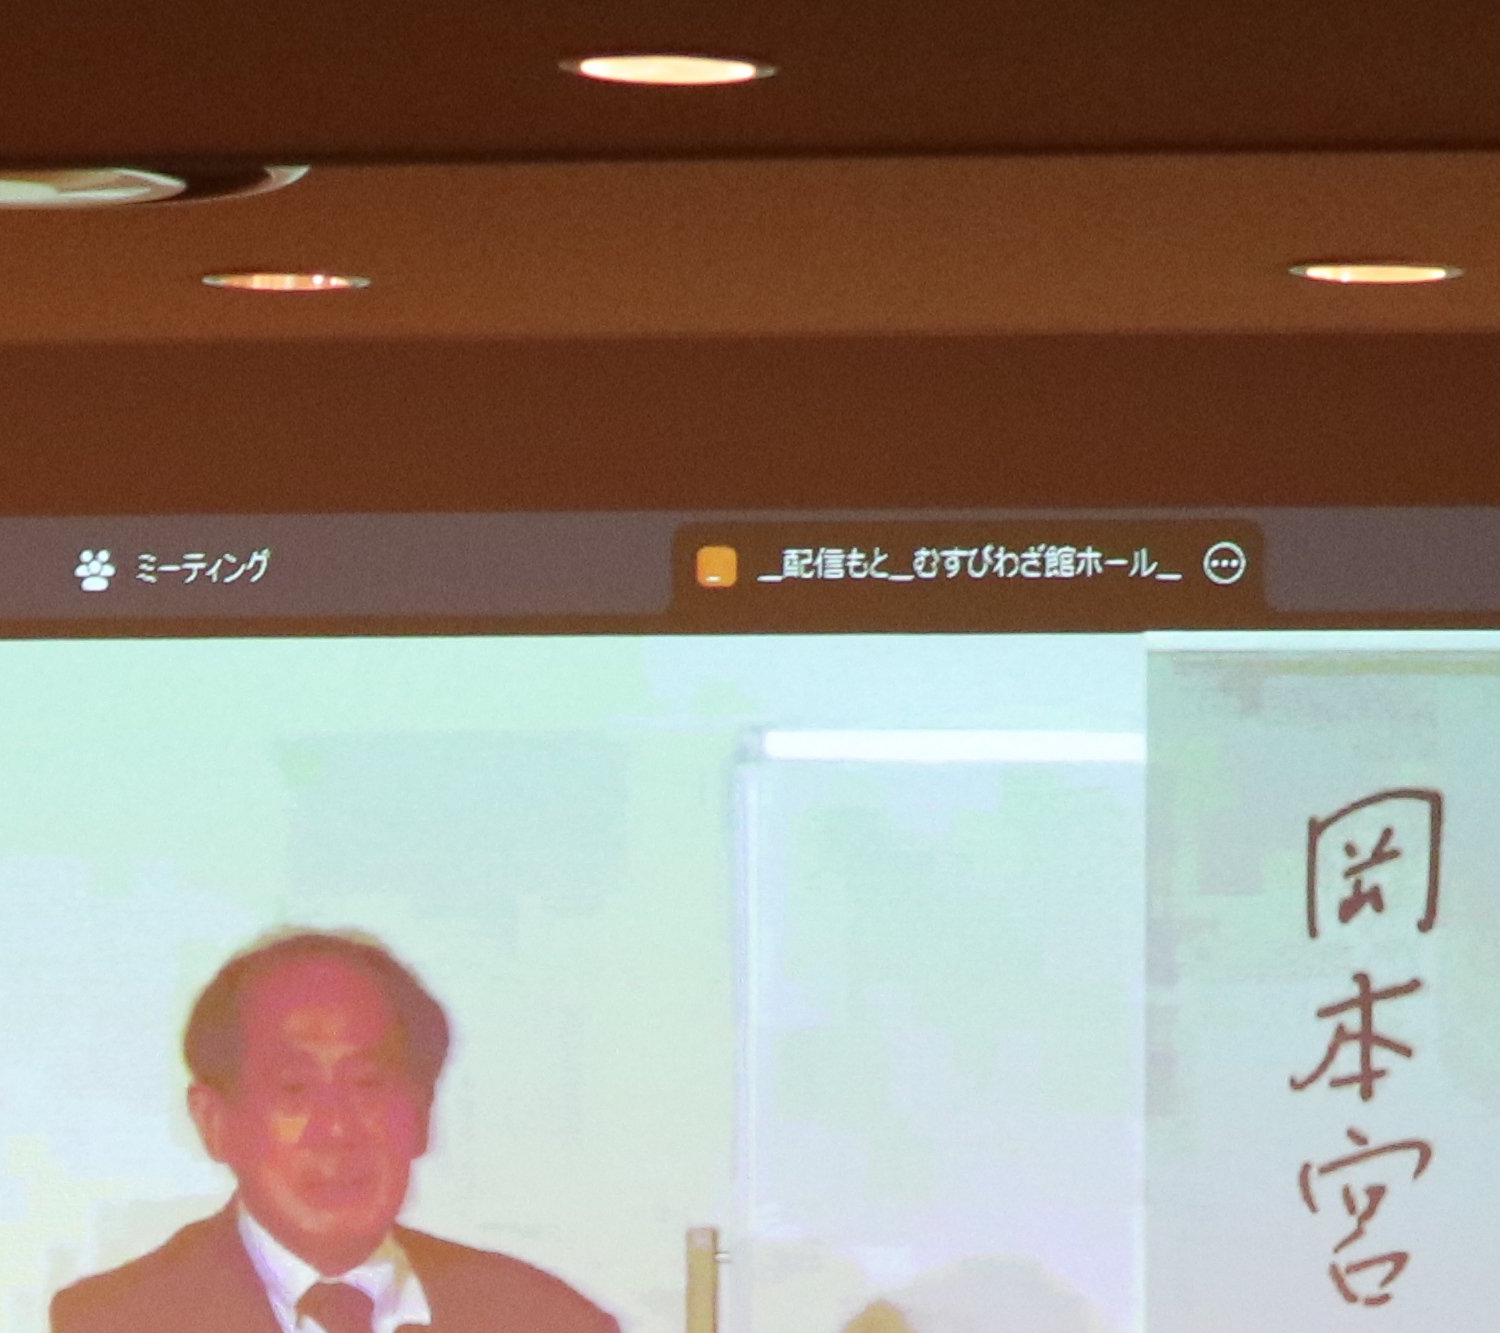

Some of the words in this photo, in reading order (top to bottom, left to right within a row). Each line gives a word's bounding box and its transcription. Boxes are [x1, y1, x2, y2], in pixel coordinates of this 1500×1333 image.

[136, 549, 270, 584] ミーティング
